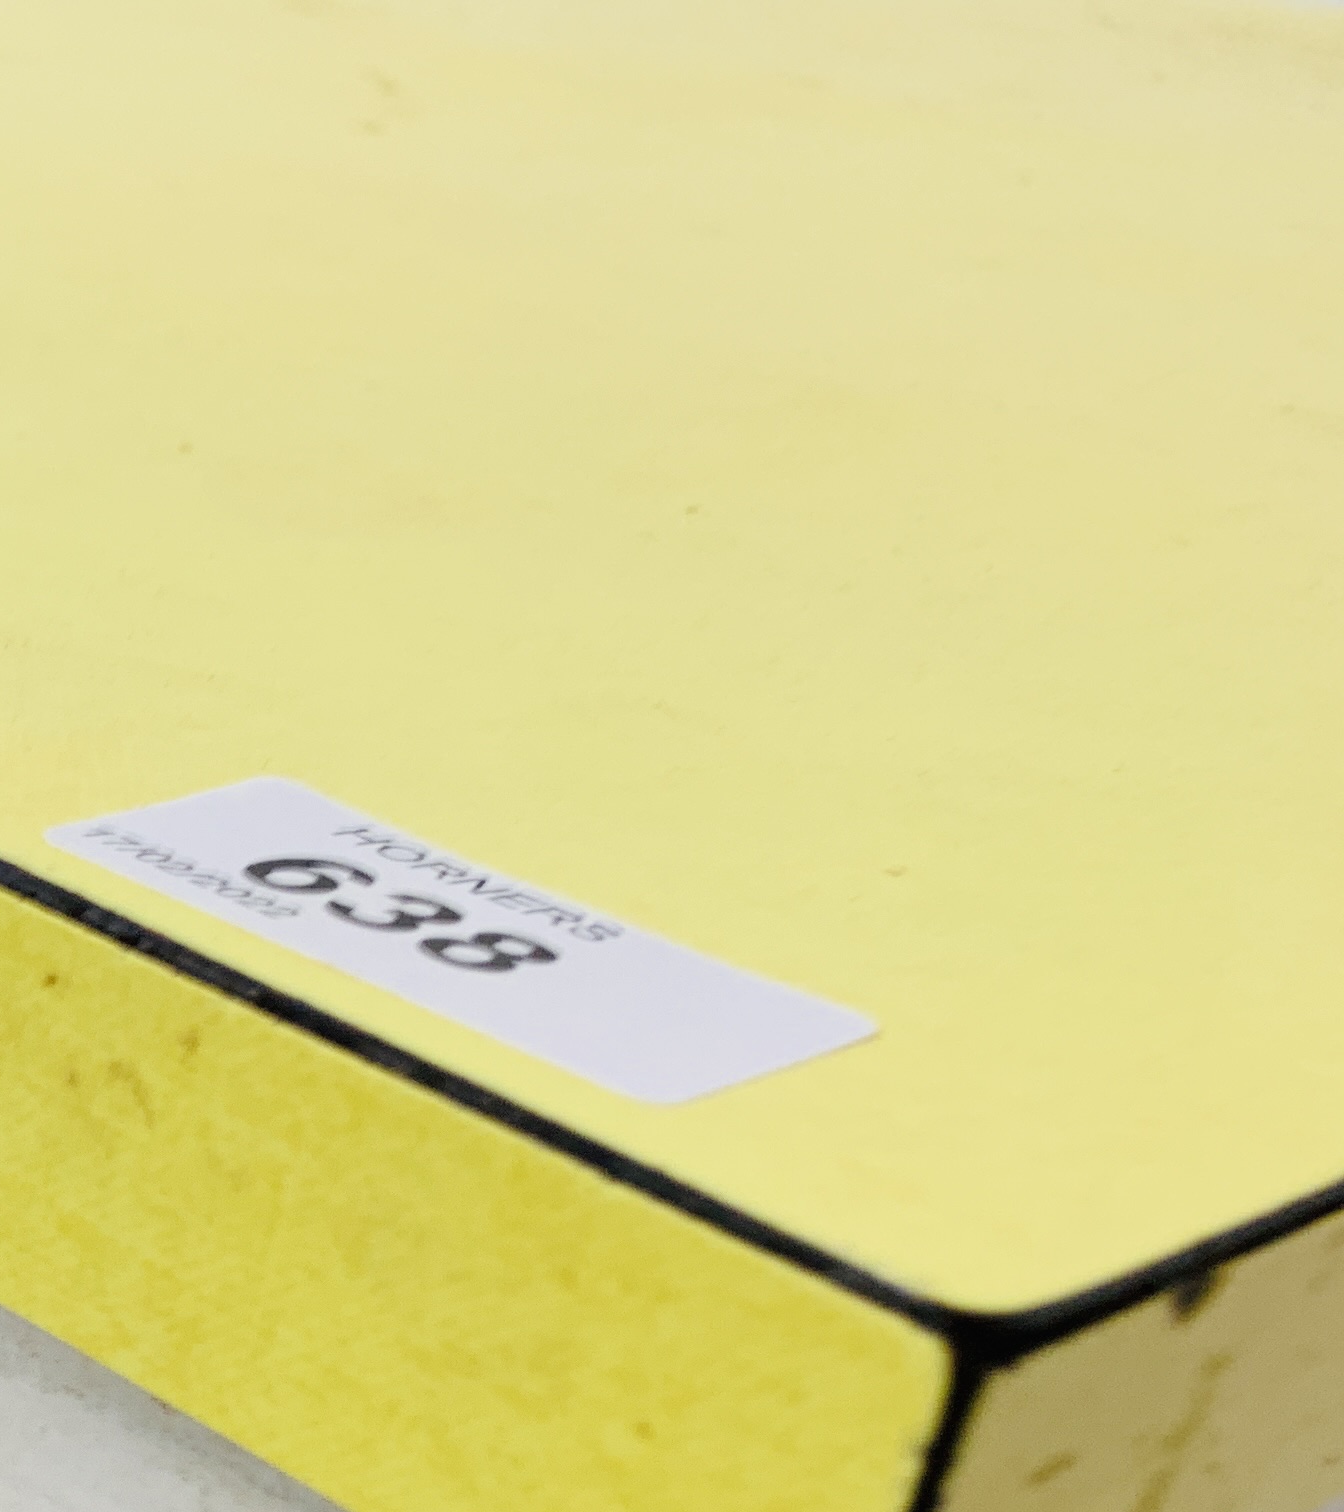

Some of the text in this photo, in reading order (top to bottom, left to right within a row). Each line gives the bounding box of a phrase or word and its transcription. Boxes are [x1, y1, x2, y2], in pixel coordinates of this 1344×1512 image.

[83, 823, 302, 920] 17/02/2022
[243, 856, 559, 973] 638
[332, 822, 624, 944] HORNERS
